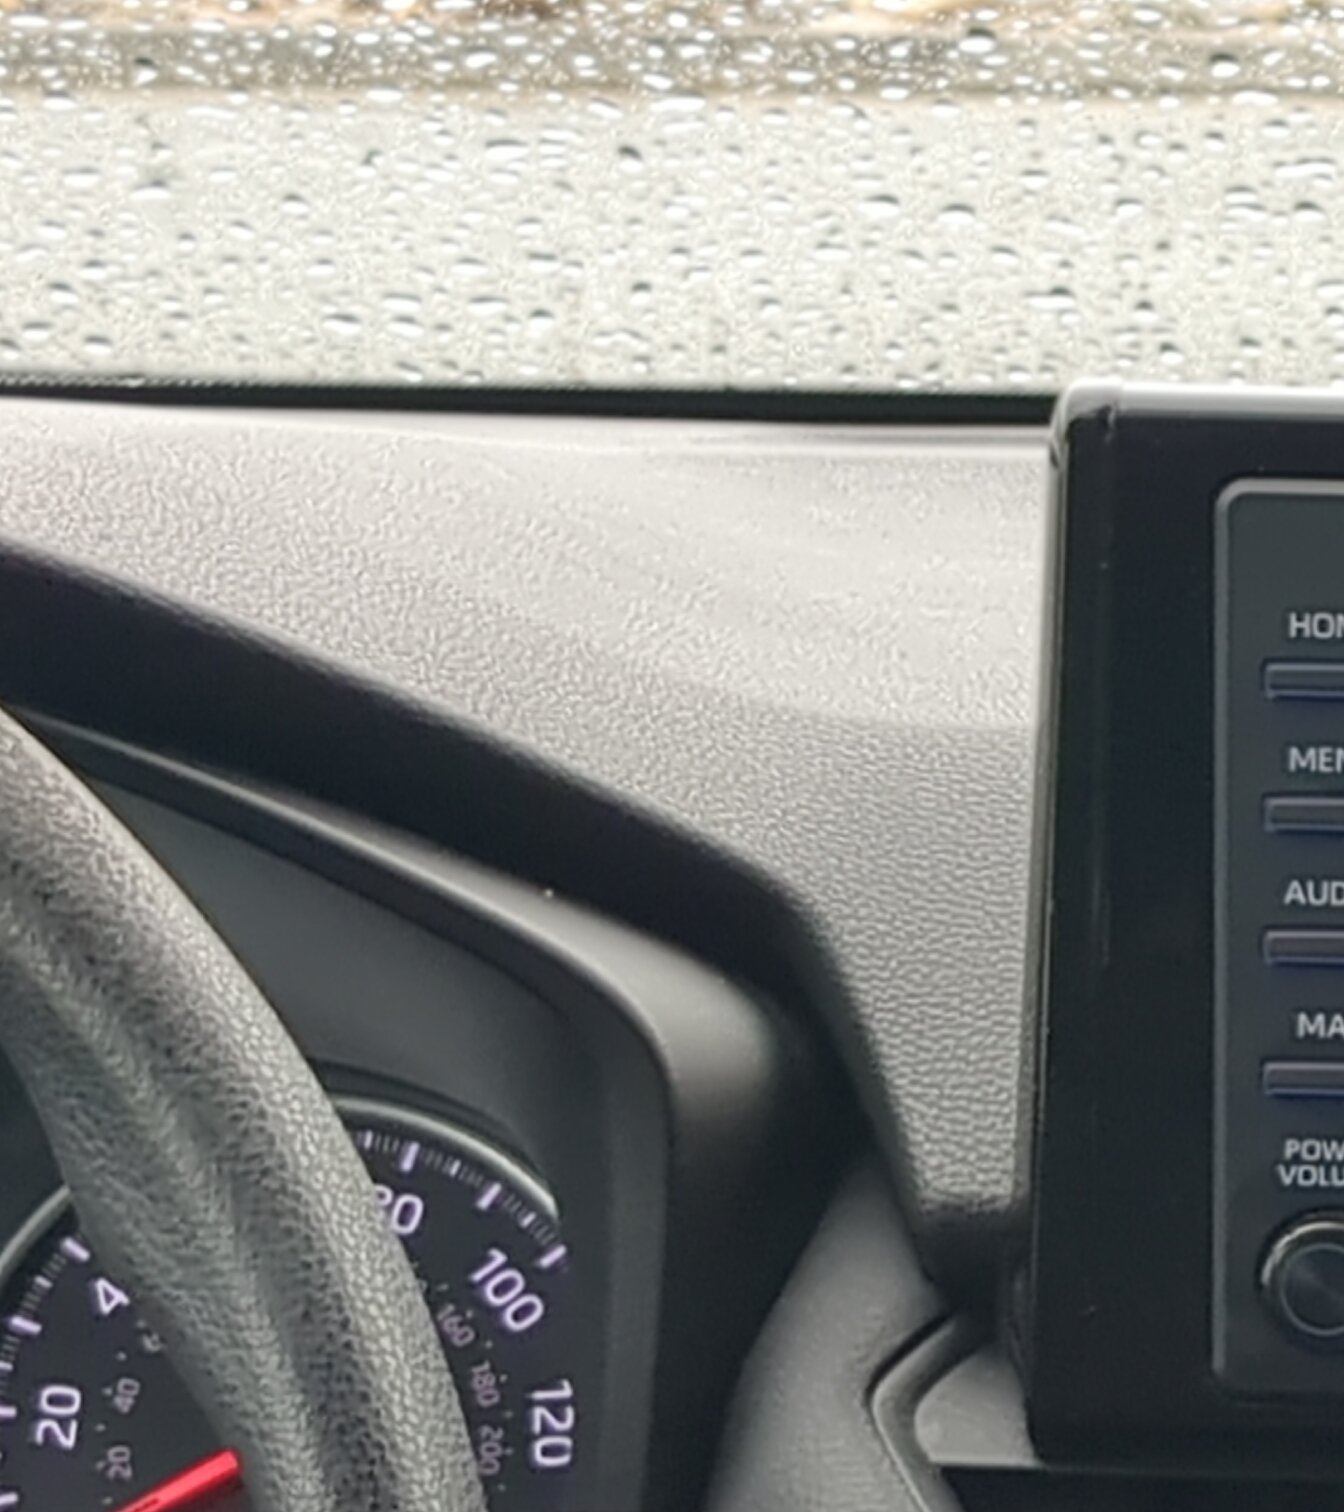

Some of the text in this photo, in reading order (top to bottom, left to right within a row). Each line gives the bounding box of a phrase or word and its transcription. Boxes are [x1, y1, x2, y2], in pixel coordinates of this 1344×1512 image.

[95, 1277, 130, 1315] 4
[471, 1248, 544, 1332] 100
[438, 1304, 475, 1346] 160
[471, 1360, 499, 1406] 180
[36, 1385, 81, 1447] 20
[531, 1380, 574, 1466] 120
[107, 1445, 132, 1479] 20
